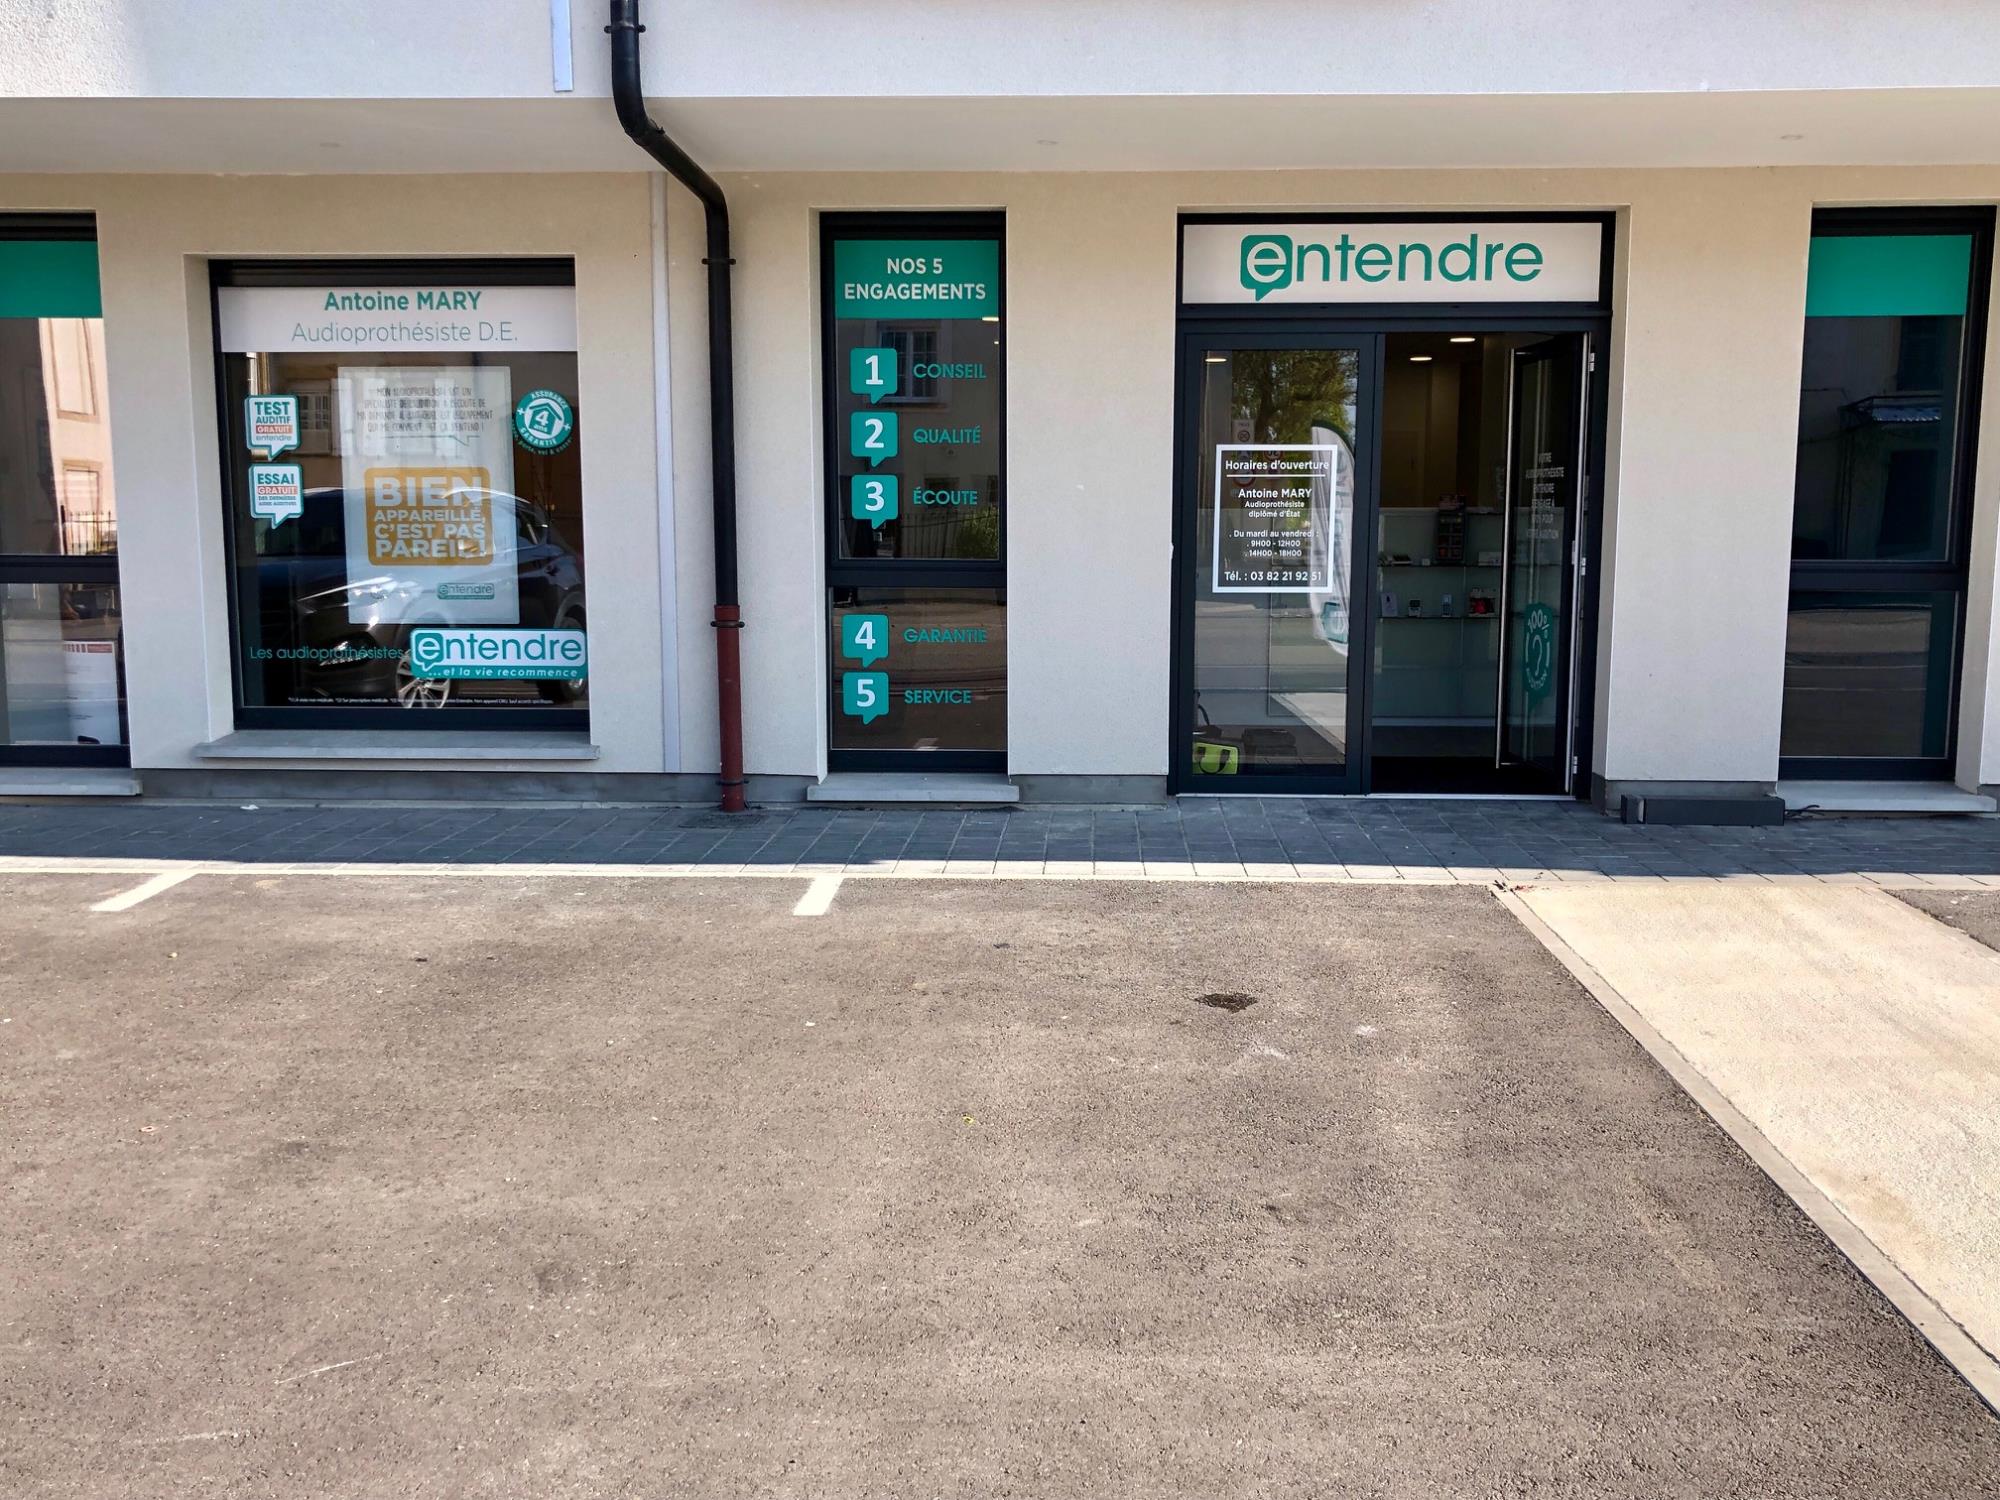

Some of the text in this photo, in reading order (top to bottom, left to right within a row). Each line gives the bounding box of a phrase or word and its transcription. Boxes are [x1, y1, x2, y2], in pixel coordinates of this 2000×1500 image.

[887, 258, 943, 274] NOS 5
[1246, 233, 1543, 283] entendre
[844, 283, 986, 300] ENGAGEMENTS
[324, 291, 482, 311] Antoine MARY
[291, 321, 518, 345] Audioprothésiste D.E.
[865, 355, 986, 385] 1 CONSEIL
[254, 401, 290, 415] TEST
[256, 416, 291, 424] AUDITIF
[535, 410, 549, 426] 4
[257, 425, 291, 434] GRATUIT
[533, 424, 548, 432] ans
[865, 418, 981, 448] 2 QUALITÉ
[1225, 460, 1330, 470] Horaires d'ouverture
[257, 473, 294, 484] ESSAI
[258, 486, 296, 495] GRATUIT
[374, 477, 482, 507] BIEN
[865, 481, 978, 512] 3 ÉCOUTE
[1238, 489, 1312, 498] Antoine MARY
[1245, 501, 1305, 509] Audioprothésiste
[374, 506, 486, 524] APPAREILLÉ,
[1248, 509, 1300, 518] diplômé d'État
[374, 523, 485, 539] C'EST PAS
[376, 539, 475, 559] PAREIL
[1224, 571, 1241, 581] Tél.
[1250, 572, 1264, 580] 03
[1267, 572, 1279, 580] 82
[1282, 572, 1292, 580] 21
[1296, 572, 1308, 580] 92
[438, 583, 493, 595] entendre
[854, 621, 988, 650] 4 GARANTIE
[250, 646, 403, 662] Les audioprothésistes
[418, 633, 582, 661] entendre
[460, 667, 470, 676] la
[475, 667, 493, 676] vie
[498, 668, 578, 677] recommence
[856, 679, 972, 707] 5 SERVICE
